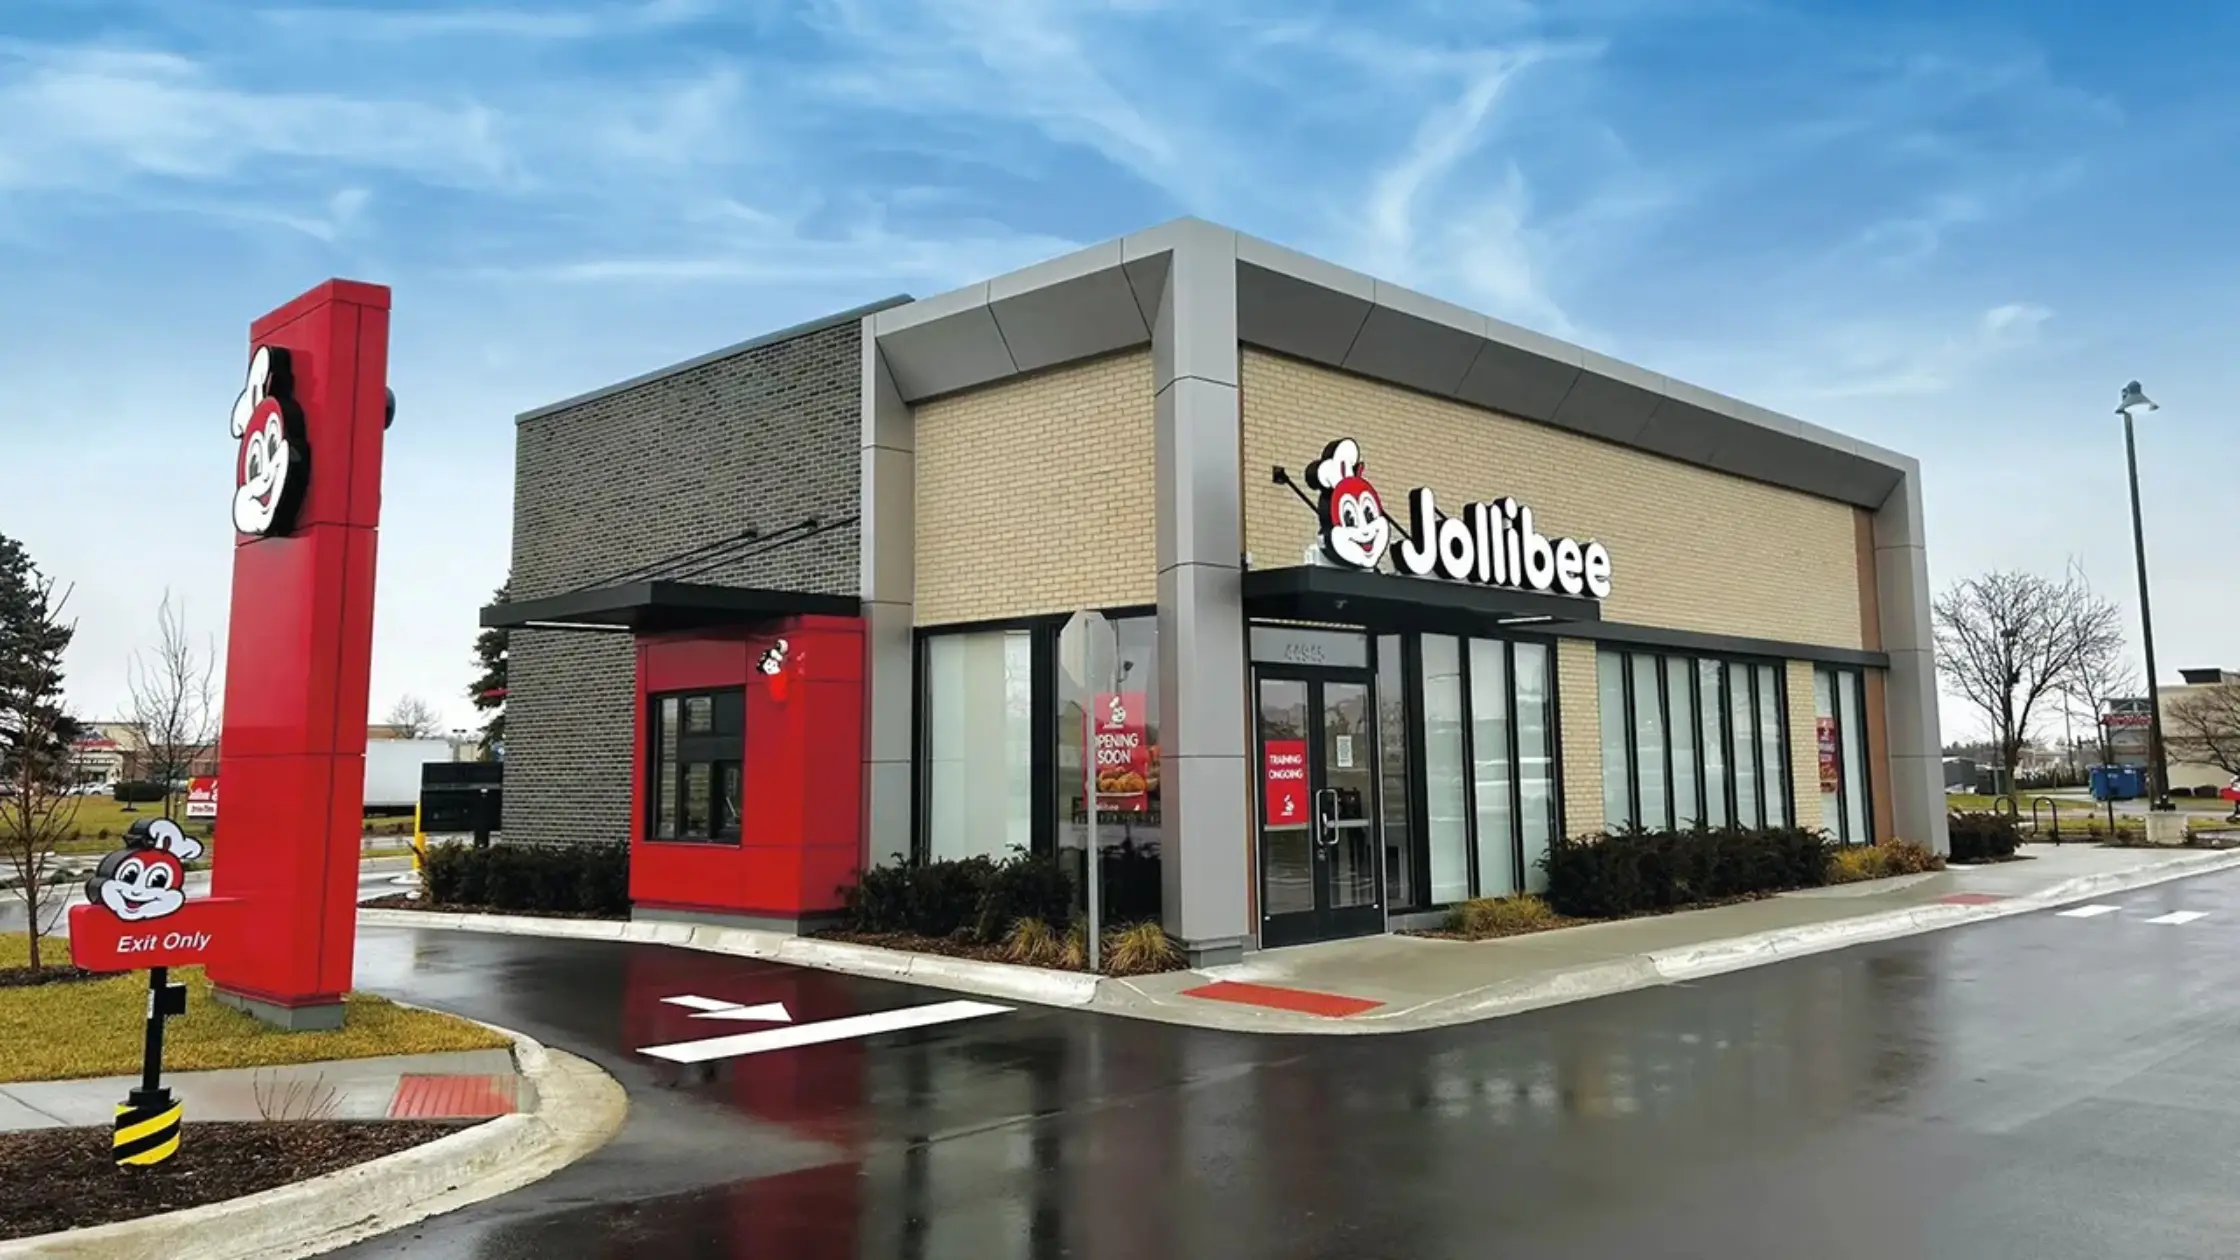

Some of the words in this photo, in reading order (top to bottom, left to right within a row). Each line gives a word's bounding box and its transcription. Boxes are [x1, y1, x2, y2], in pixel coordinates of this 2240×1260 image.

[1396, 486, 1612, 598] Jollibee
[1097, 749, 1132, 764] SOON
[1269, 754, 1302, 765] TRAINING
[1268, 769, 1304, 779] ONGOING
[117, 935, 158, 952] Exit
[162, 931, 212, 951] Only
